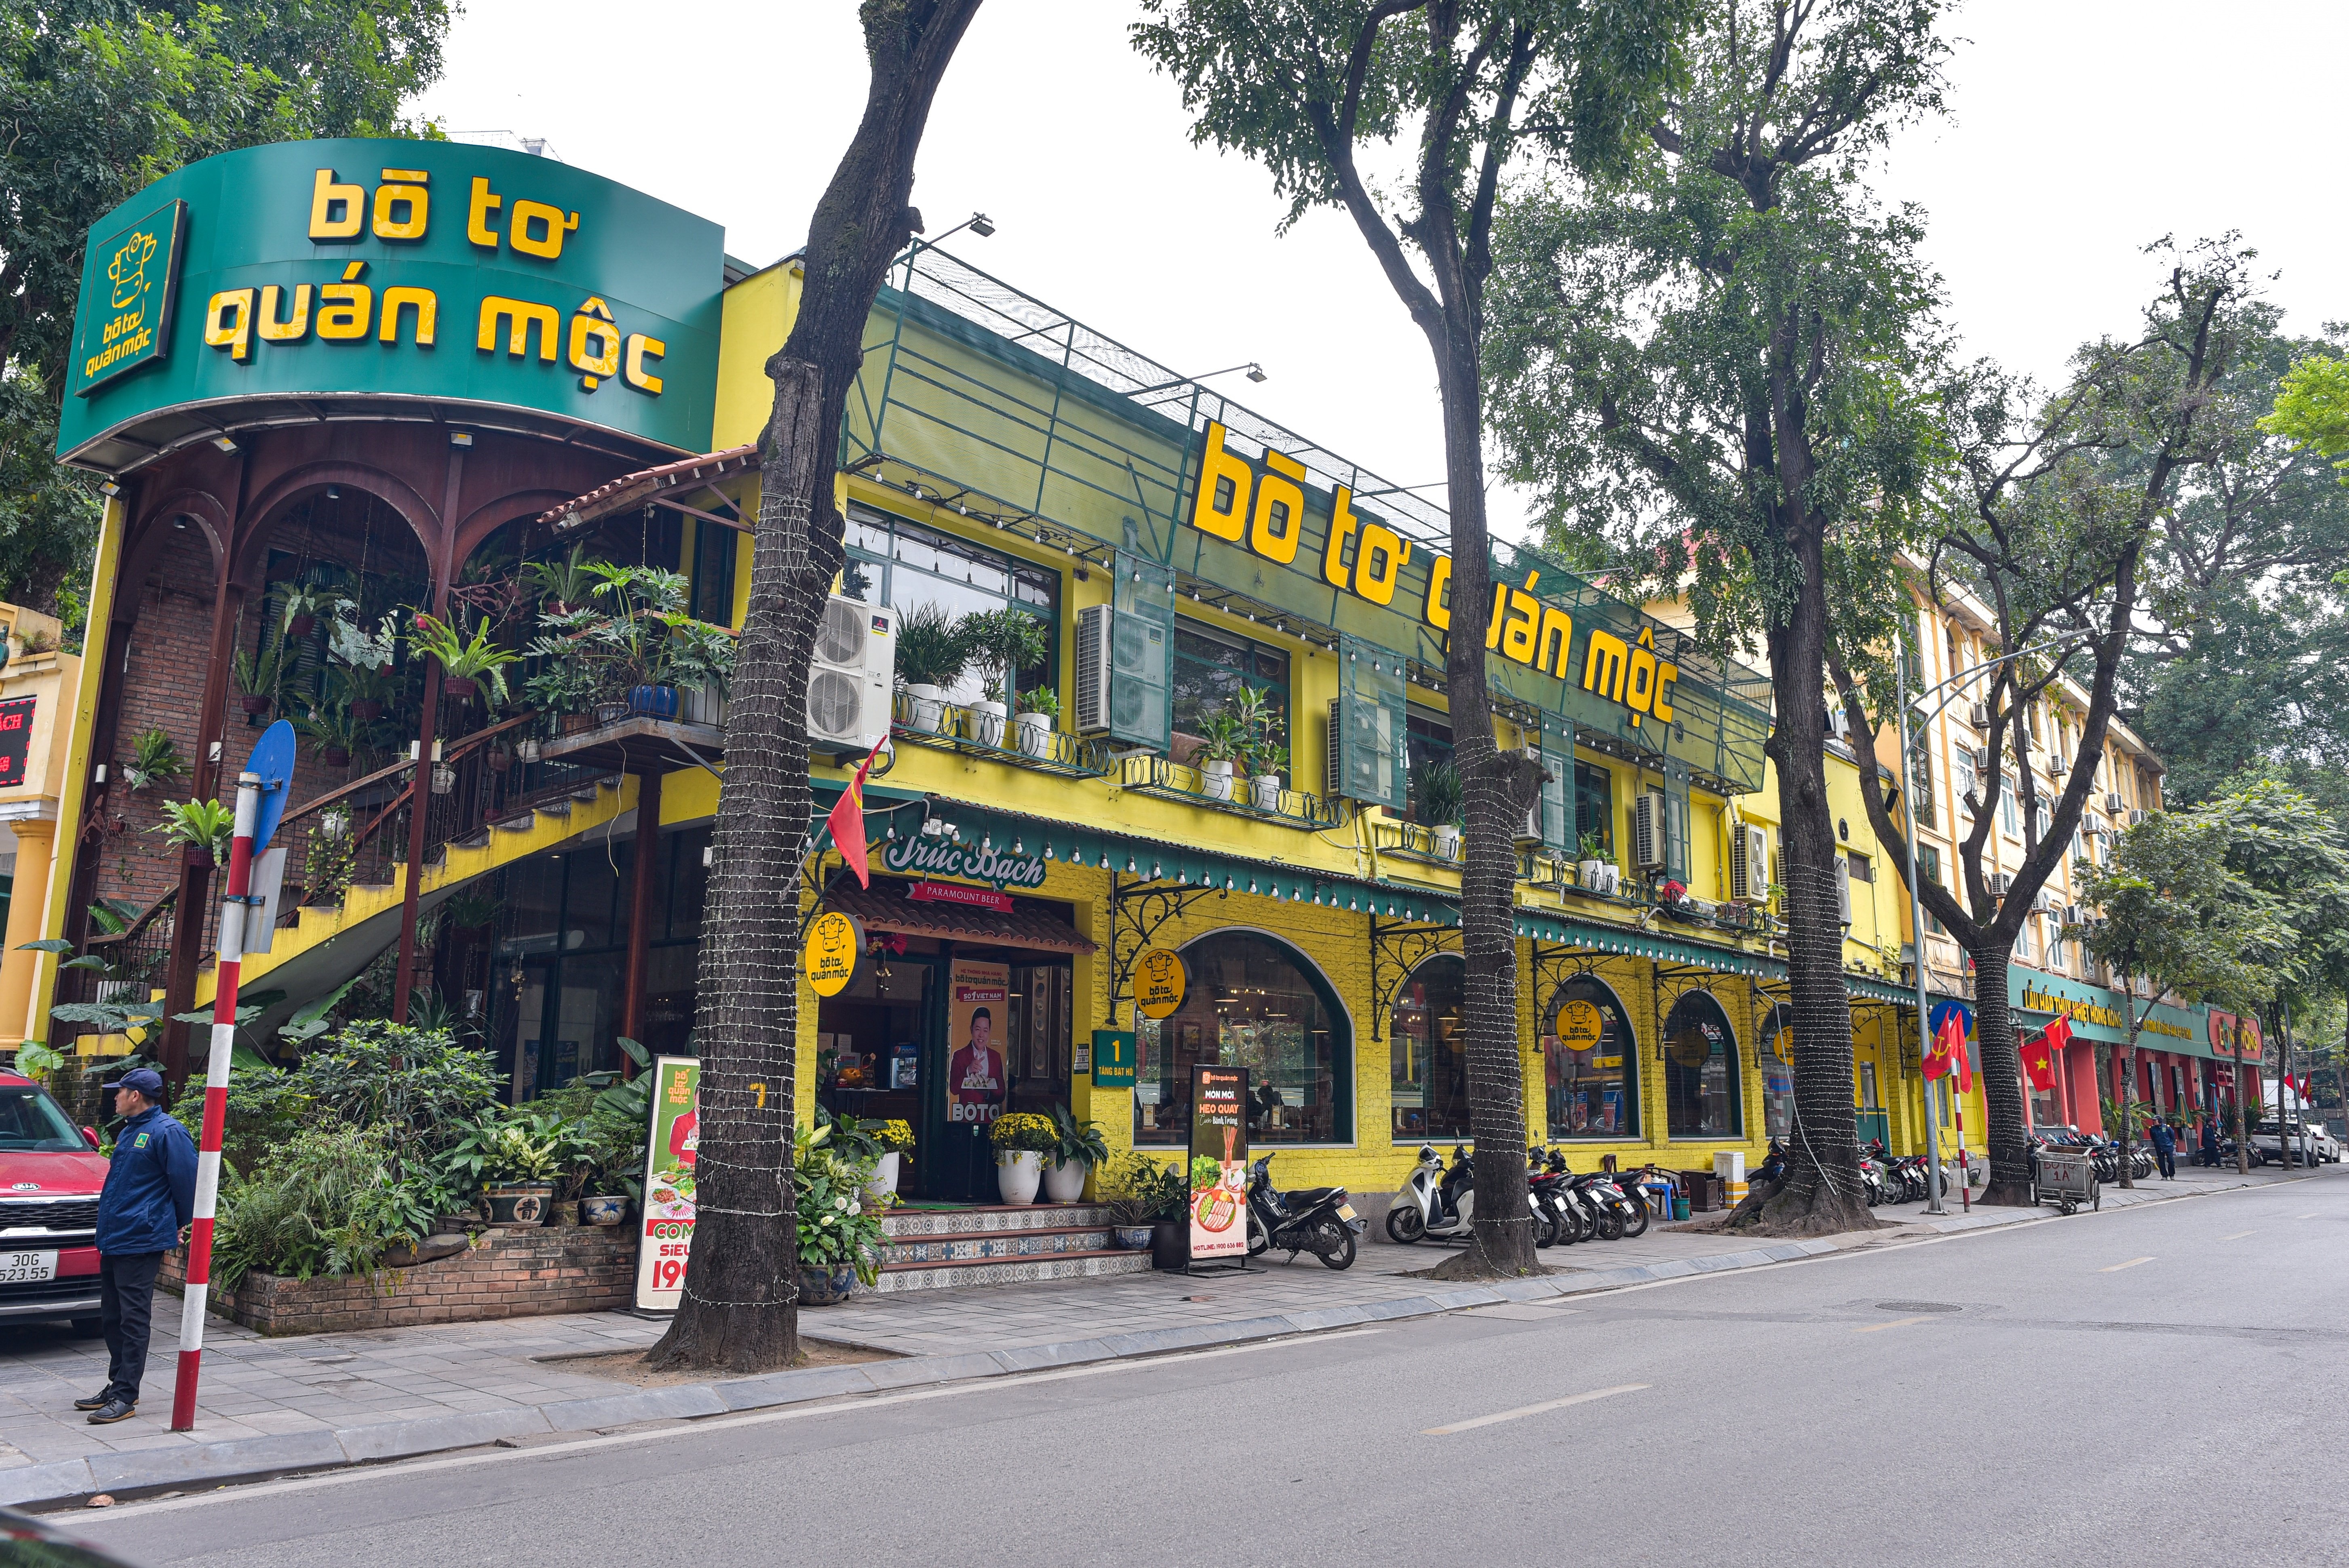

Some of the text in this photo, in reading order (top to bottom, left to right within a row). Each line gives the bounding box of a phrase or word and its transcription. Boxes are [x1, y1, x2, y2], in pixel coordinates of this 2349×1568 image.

[467, 176, 581, 262] tơ
[204, 261, 667, 397] quán mộc
[85, 327, 151, 378] quán mộc
[1320, 484, 1411, 607] tơ
[1579, 625, 1679, 728] mộc
[964, 845, 1043, 885] Bạch
[927, 886, 999, 904] PARAMOUNT BEER
[811, 965, 849, 983] quán mộc
[973, 976, 991, 985] quán
[991, 977, 1007, 987] mộc
[972, 991, 976, 1000] 1
[1141, 993, 1178, 1007] quán mộc
[2040, 984, 2054, 1012] HẤP
[2090, 996, 2107, 1026] HỒNG
[2107, 1003, 2122, 1028] KÔNG
[1562, 1033, 1596, 1042] quán mộc
[1112, 1040, 1120, 1062] 1
[1114, 1067, 1125, 1078] BẠT
[668, 1085, 690, 1096] quán
[1205, 1086, 1221, 1099] MÓN
[669, 1094, 688, 1105] mộc
[1199, 1104, 1239, 1114] HEO QUAY
[1212, 1116, 1224, 1125] Bánh
[1224, 1116, 1238, 1126] Tráng
[2053, 1170, 2070, 1181] 1A
[11, 1254, 39, 1267] 30G
[0, 1267, 49, 1281] 523.55
